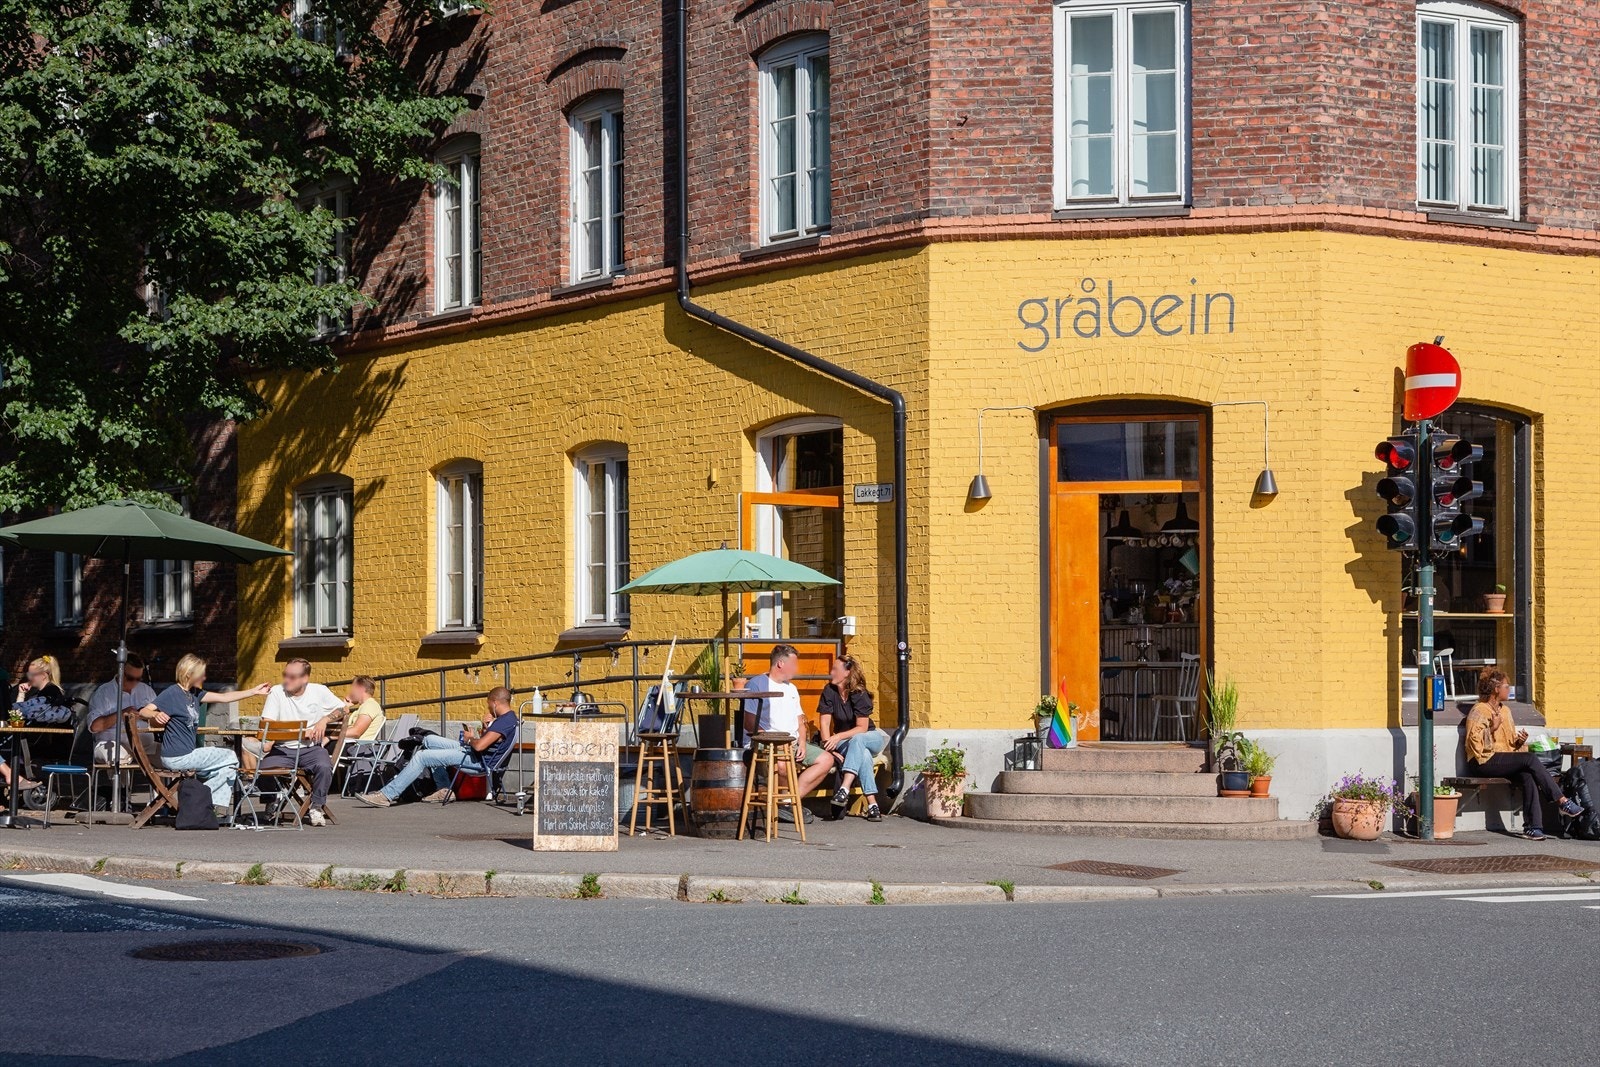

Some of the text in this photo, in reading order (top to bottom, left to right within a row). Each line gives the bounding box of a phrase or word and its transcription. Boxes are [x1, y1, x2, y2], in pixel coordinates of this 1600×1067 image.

[1017, 277, 1235, 352] gråbein
[538, 737, 616, 759] gråbein
[563, 786, 578, 796] svak
[579, 785, 588, 796] for
[589, 784, 609, 796] kake?
[543, 800, 605, 815] Husker du utepils?
[558, 821, 568, 830] om
